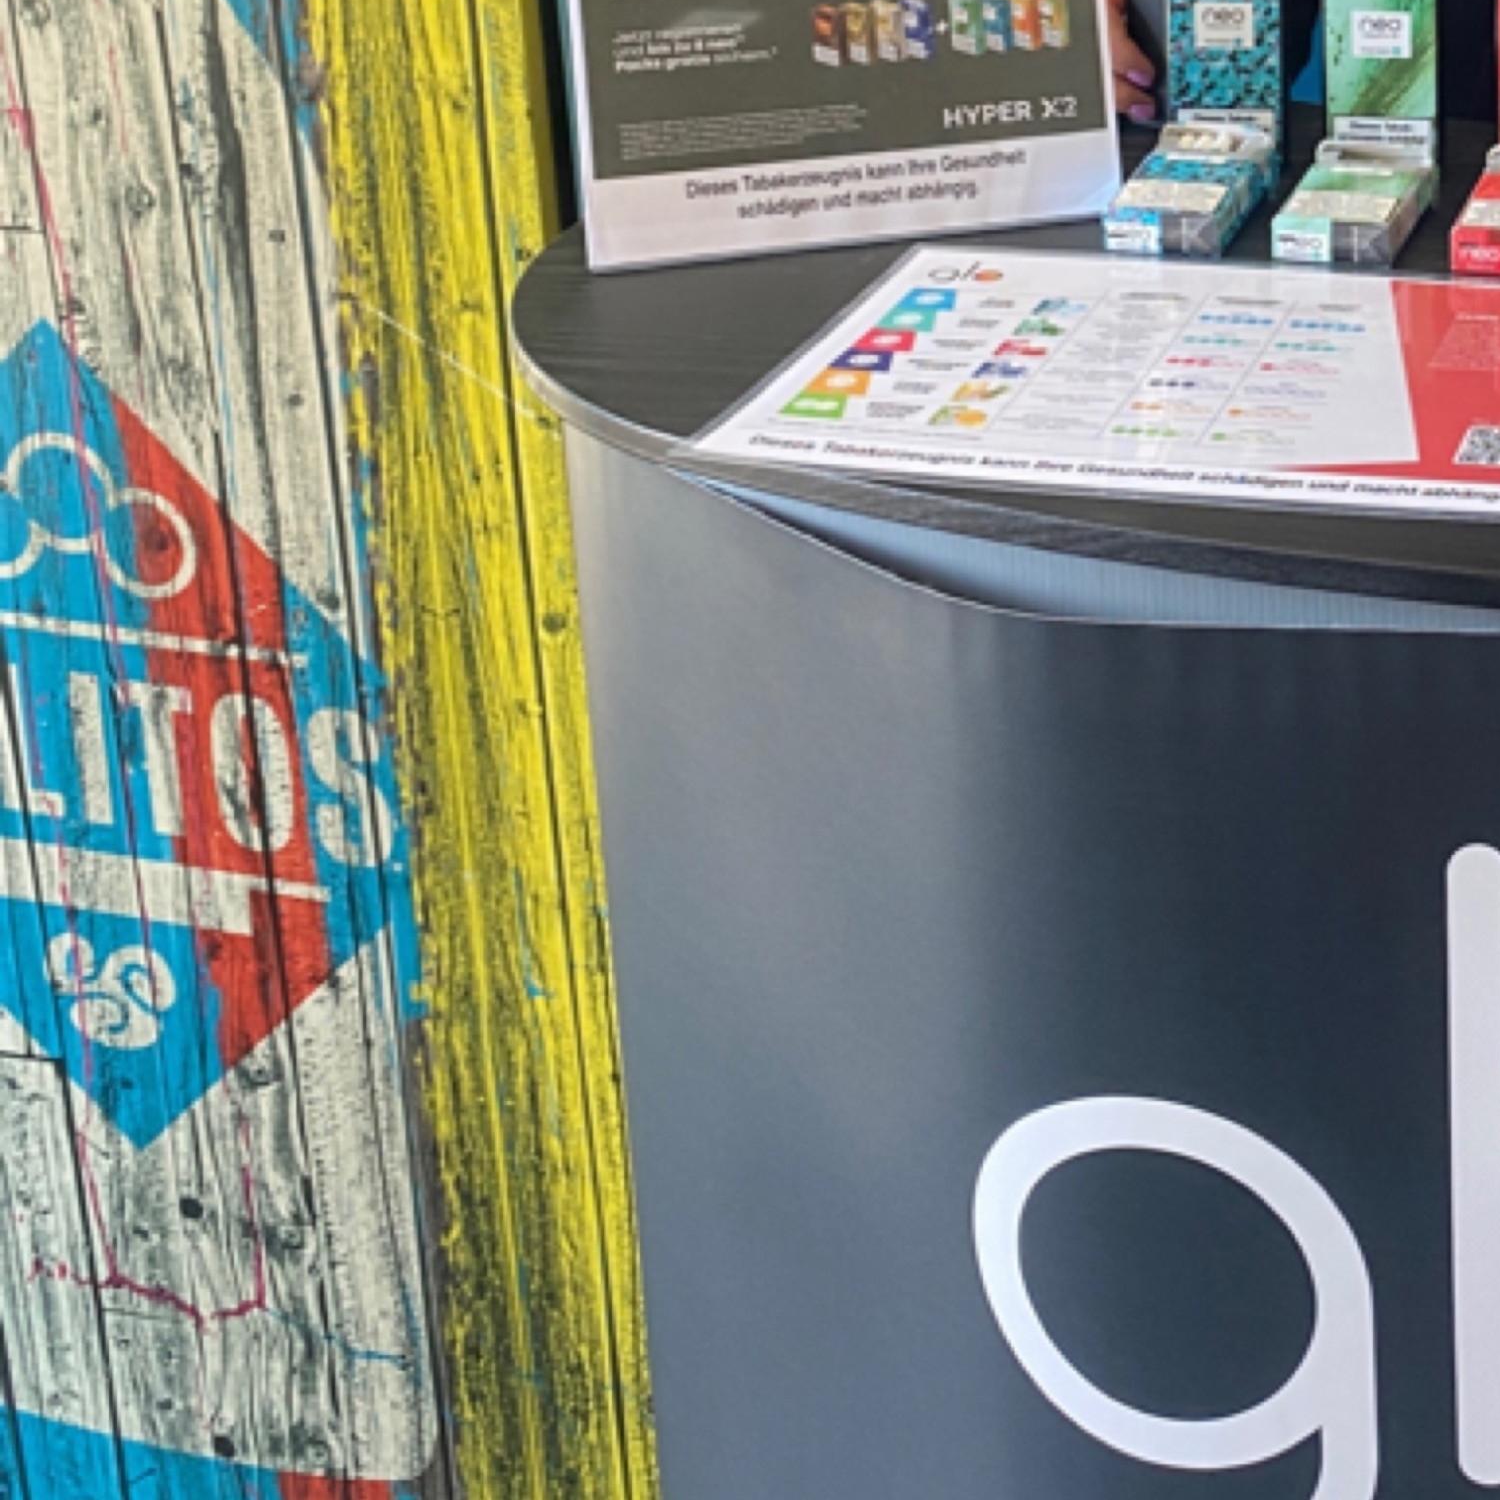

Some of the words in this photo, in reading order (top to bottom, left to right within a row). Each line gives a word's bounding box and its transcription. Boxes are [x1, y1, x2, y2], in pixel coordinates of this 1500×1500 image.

[943, 99, 1033, 129] HYPER
[1041, 94, 1078, 118] X2
[686, 179, 738, 200] Dieses
[741, 162, 863, 192] Tabakerzeugnis
[866, 160, 905, 180] kann
[908, 158, 937, 176] Ihre
[940, 148, 1027, 173] Gesundheit
[737, 195, 820, 219] schädigen
[823, 190, 852, 211] und
[857, 184, 901, 205] macht
